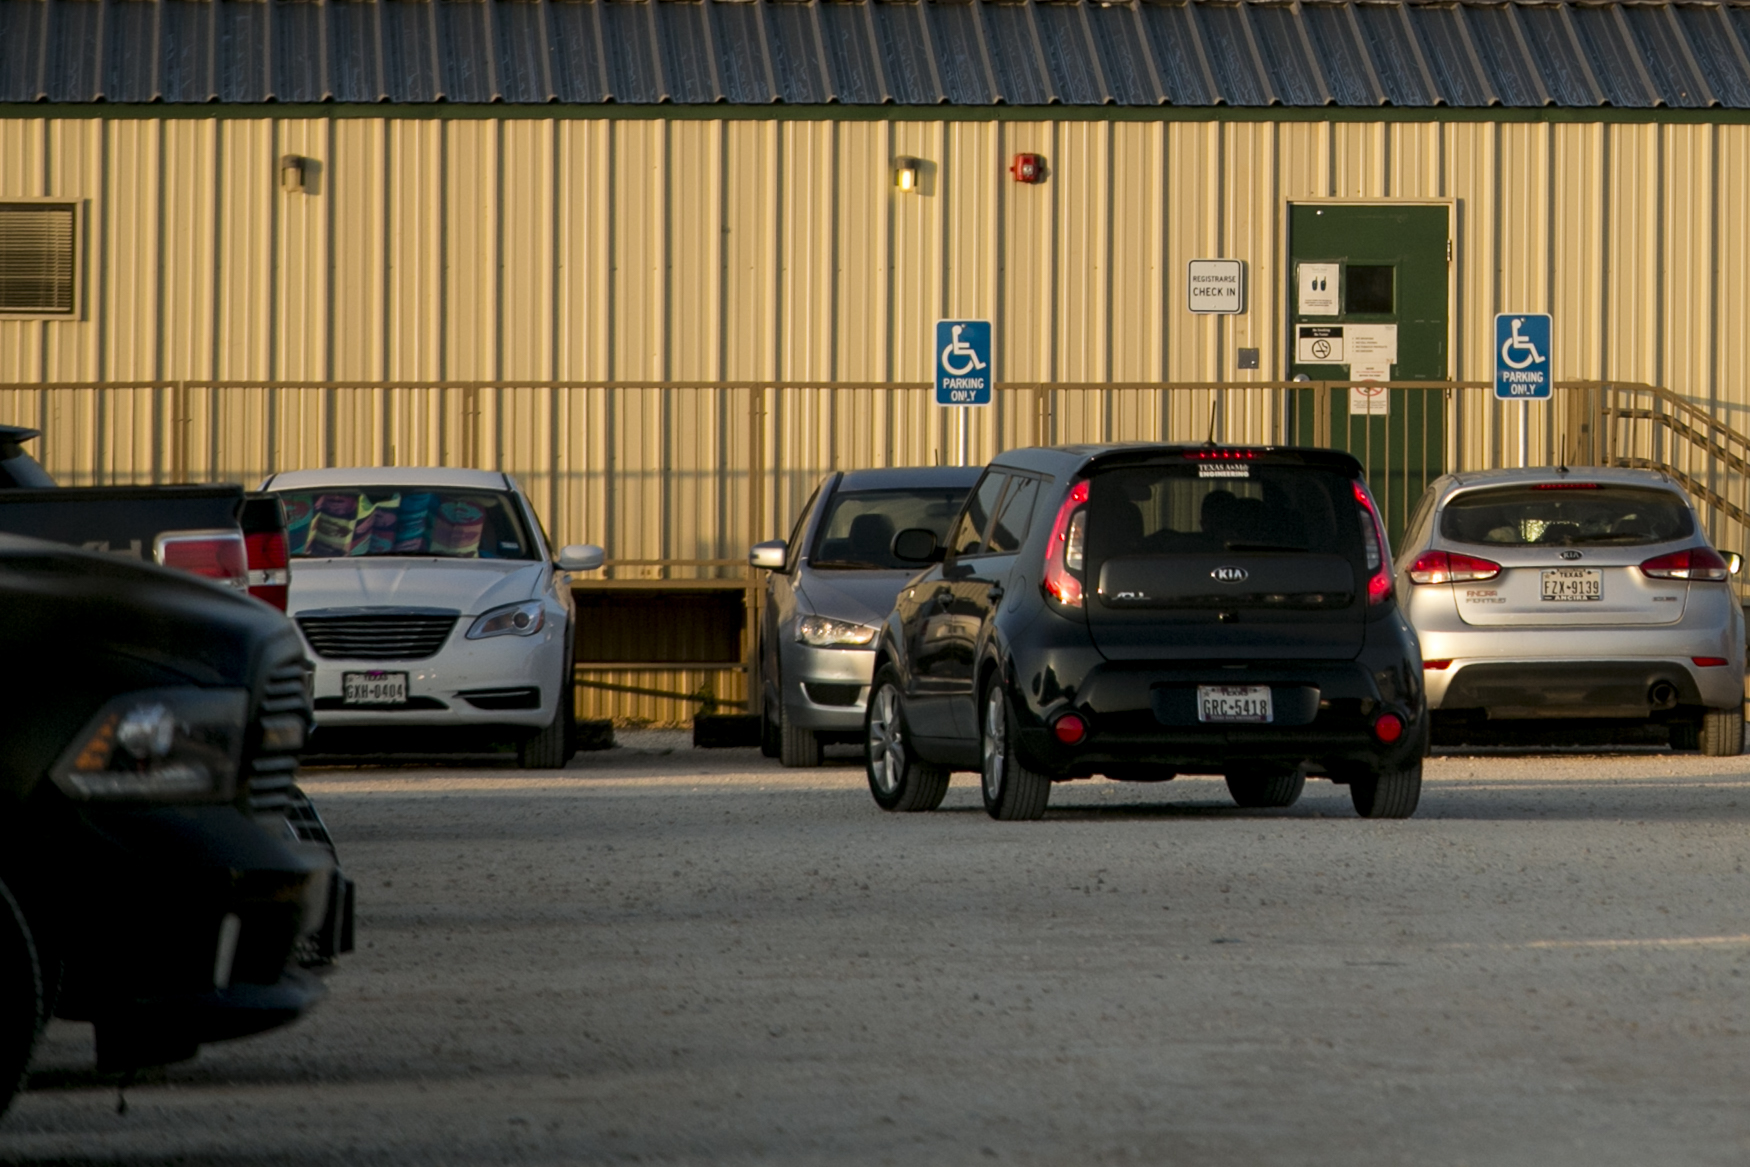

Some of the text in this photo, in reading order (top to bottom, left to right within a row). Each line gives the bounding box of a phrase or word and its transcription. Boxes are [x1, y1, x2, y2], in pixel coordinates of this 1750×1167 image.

[1192, 275, 1236, 283] REGISTRARSE
[1192, 287, 1236, 296] CHECK IN
[1502, 371, 1544, 382] PARKING
[942, 378, 984, 389] PARKING
[1510, 384, 1536, 395] ONLY
[950, 390, 976, 401] ONLY
[1218, 569, 1243, 580] KIA
